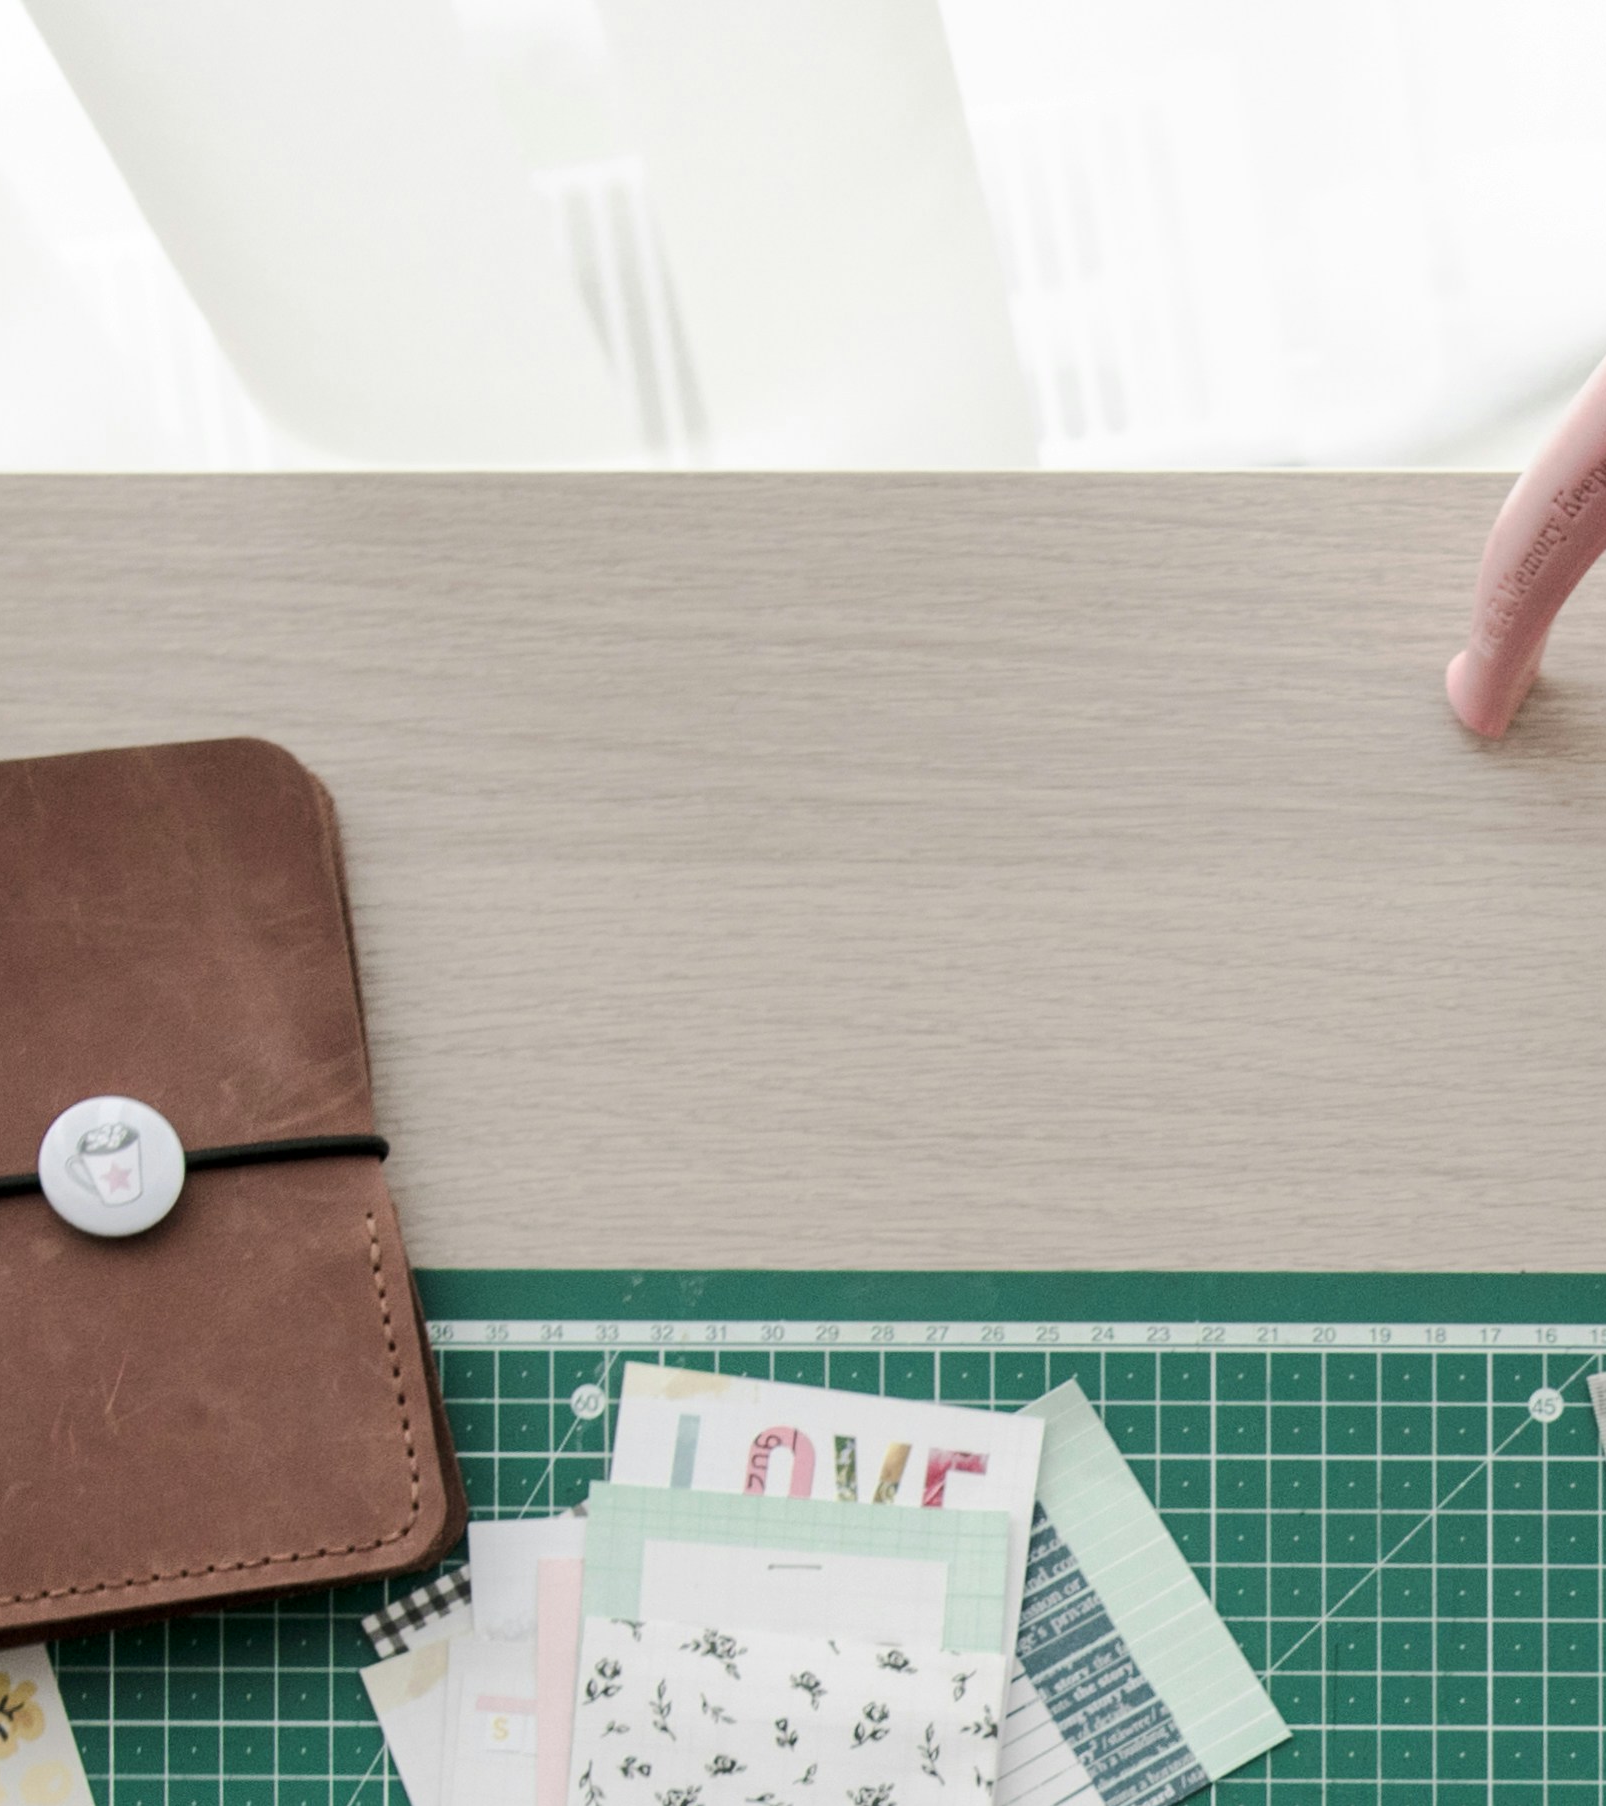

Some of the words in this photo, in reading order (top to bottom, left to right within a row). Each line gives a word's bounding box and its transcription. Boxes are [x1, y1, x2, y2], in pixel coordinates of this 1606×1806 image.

[541, 1325, 564, 1342] 34
[651, 1325, 674, 1342] 32
[762, 1325, 784, 1342] 30
[871, 1325, 894, 1342] 28
